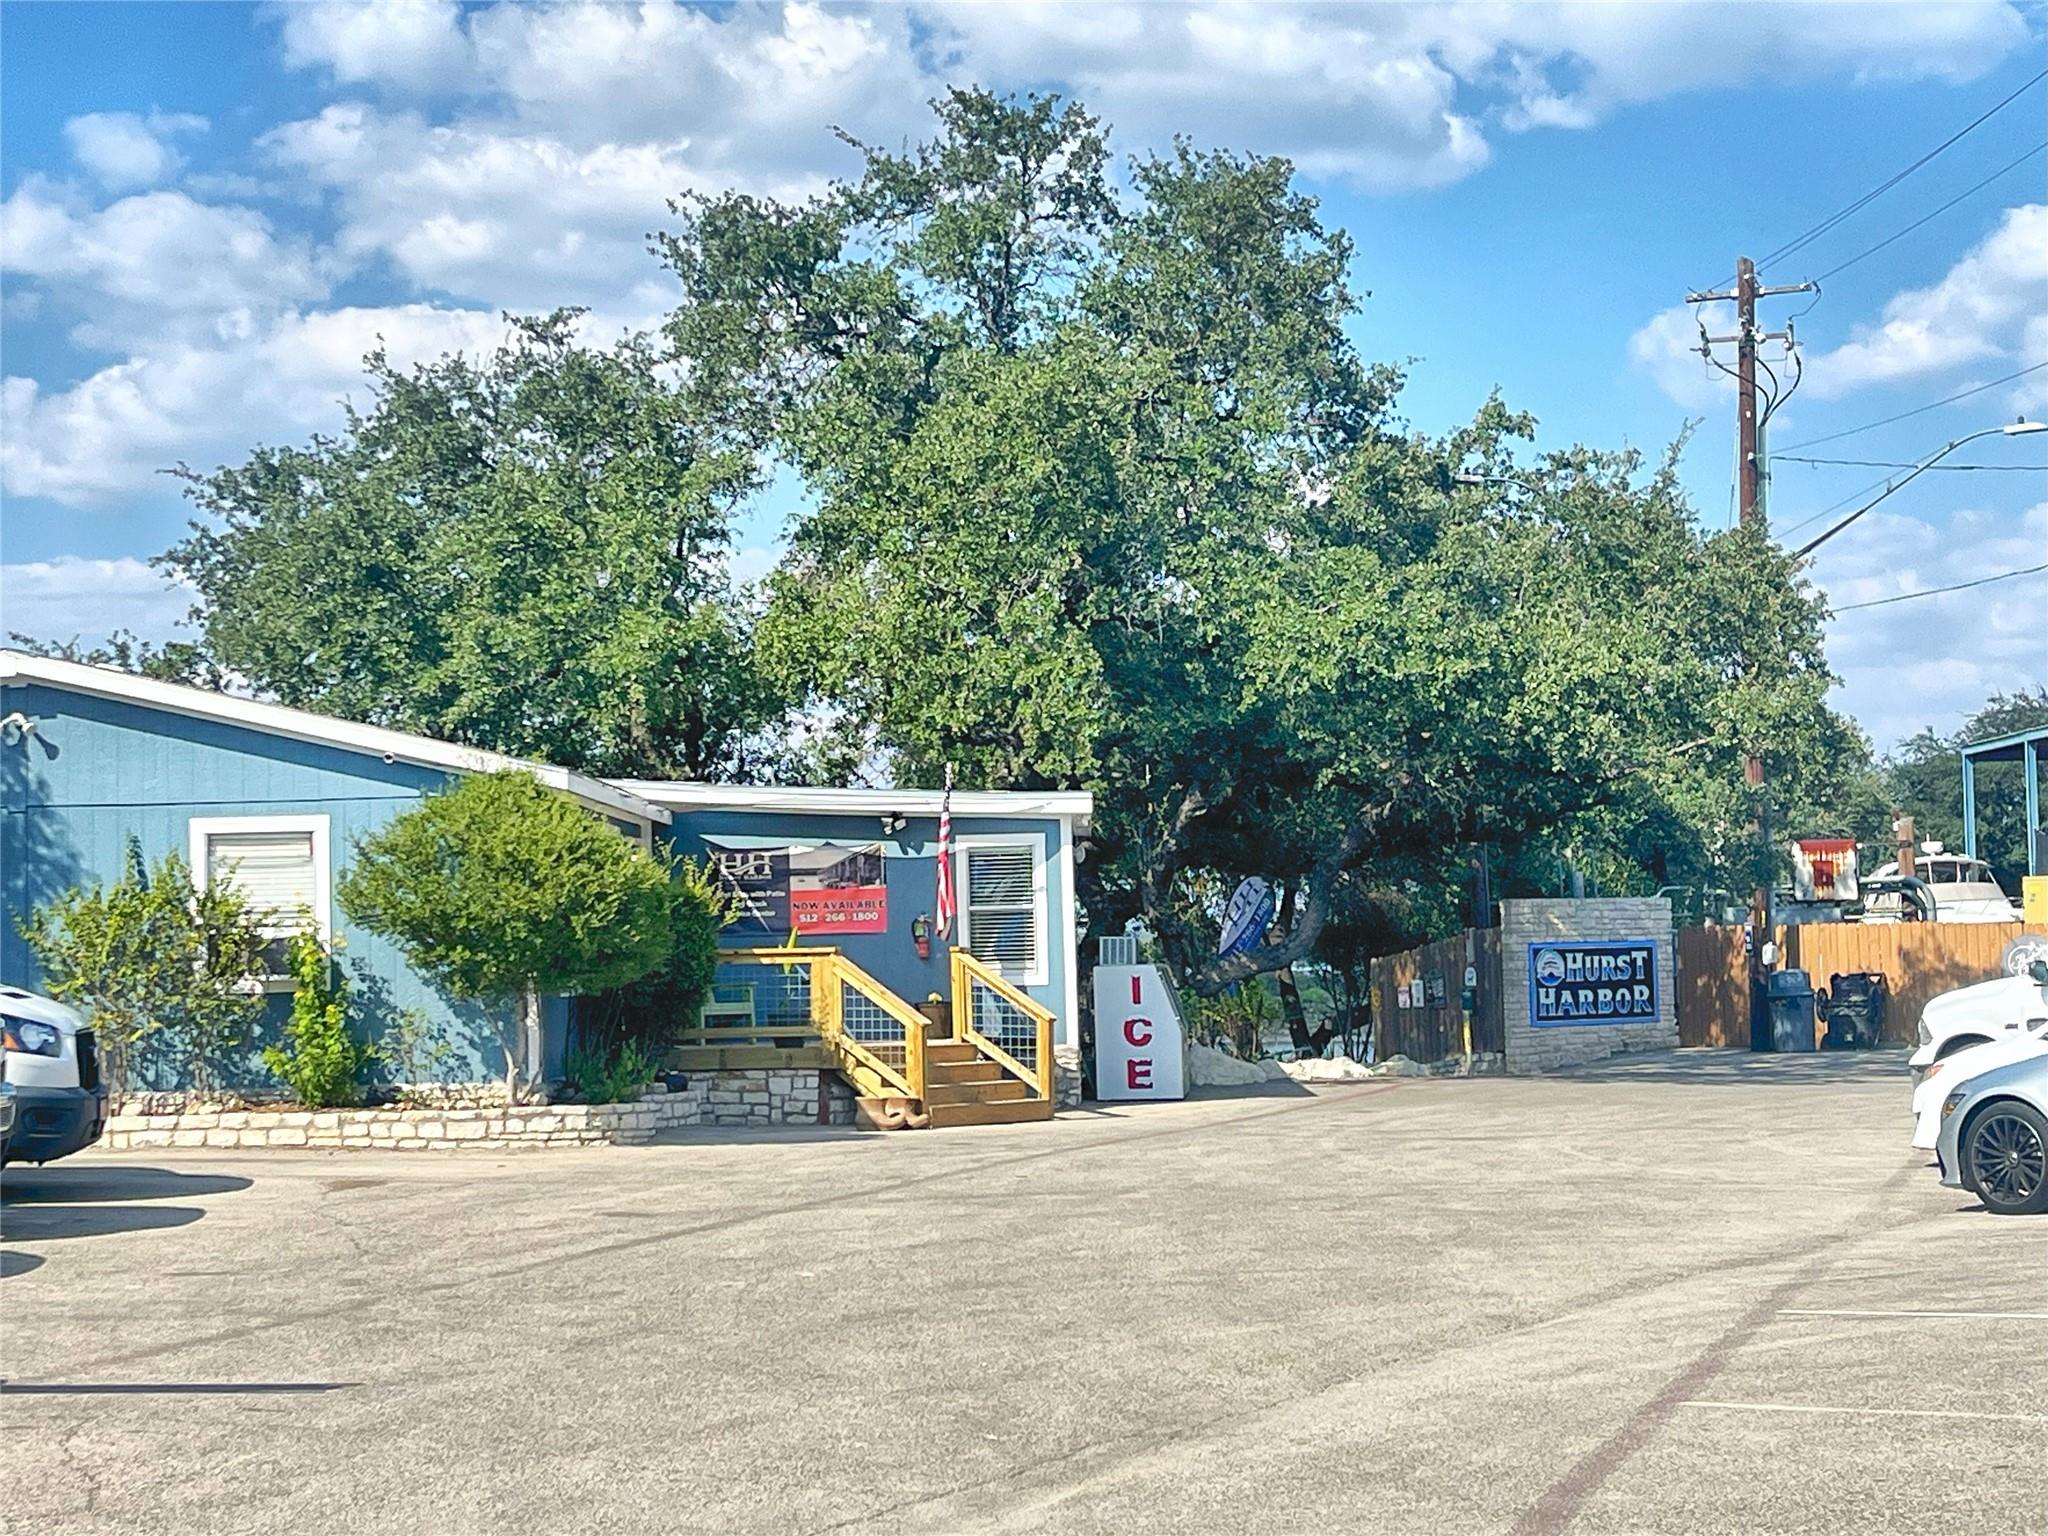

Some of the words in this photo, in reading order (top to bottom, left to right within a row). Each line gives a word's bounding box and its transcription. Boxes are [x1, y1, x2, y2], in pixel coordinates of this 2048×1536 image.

[793, 901, 818, 910] NOW
[823, 899, 885, 909] AVAILABLE
[1564, 950, 1648, 982] HURST
[1538, 984, 1653, 1016] HARBOR
[1123, 975, 1154, 1090] ICE
